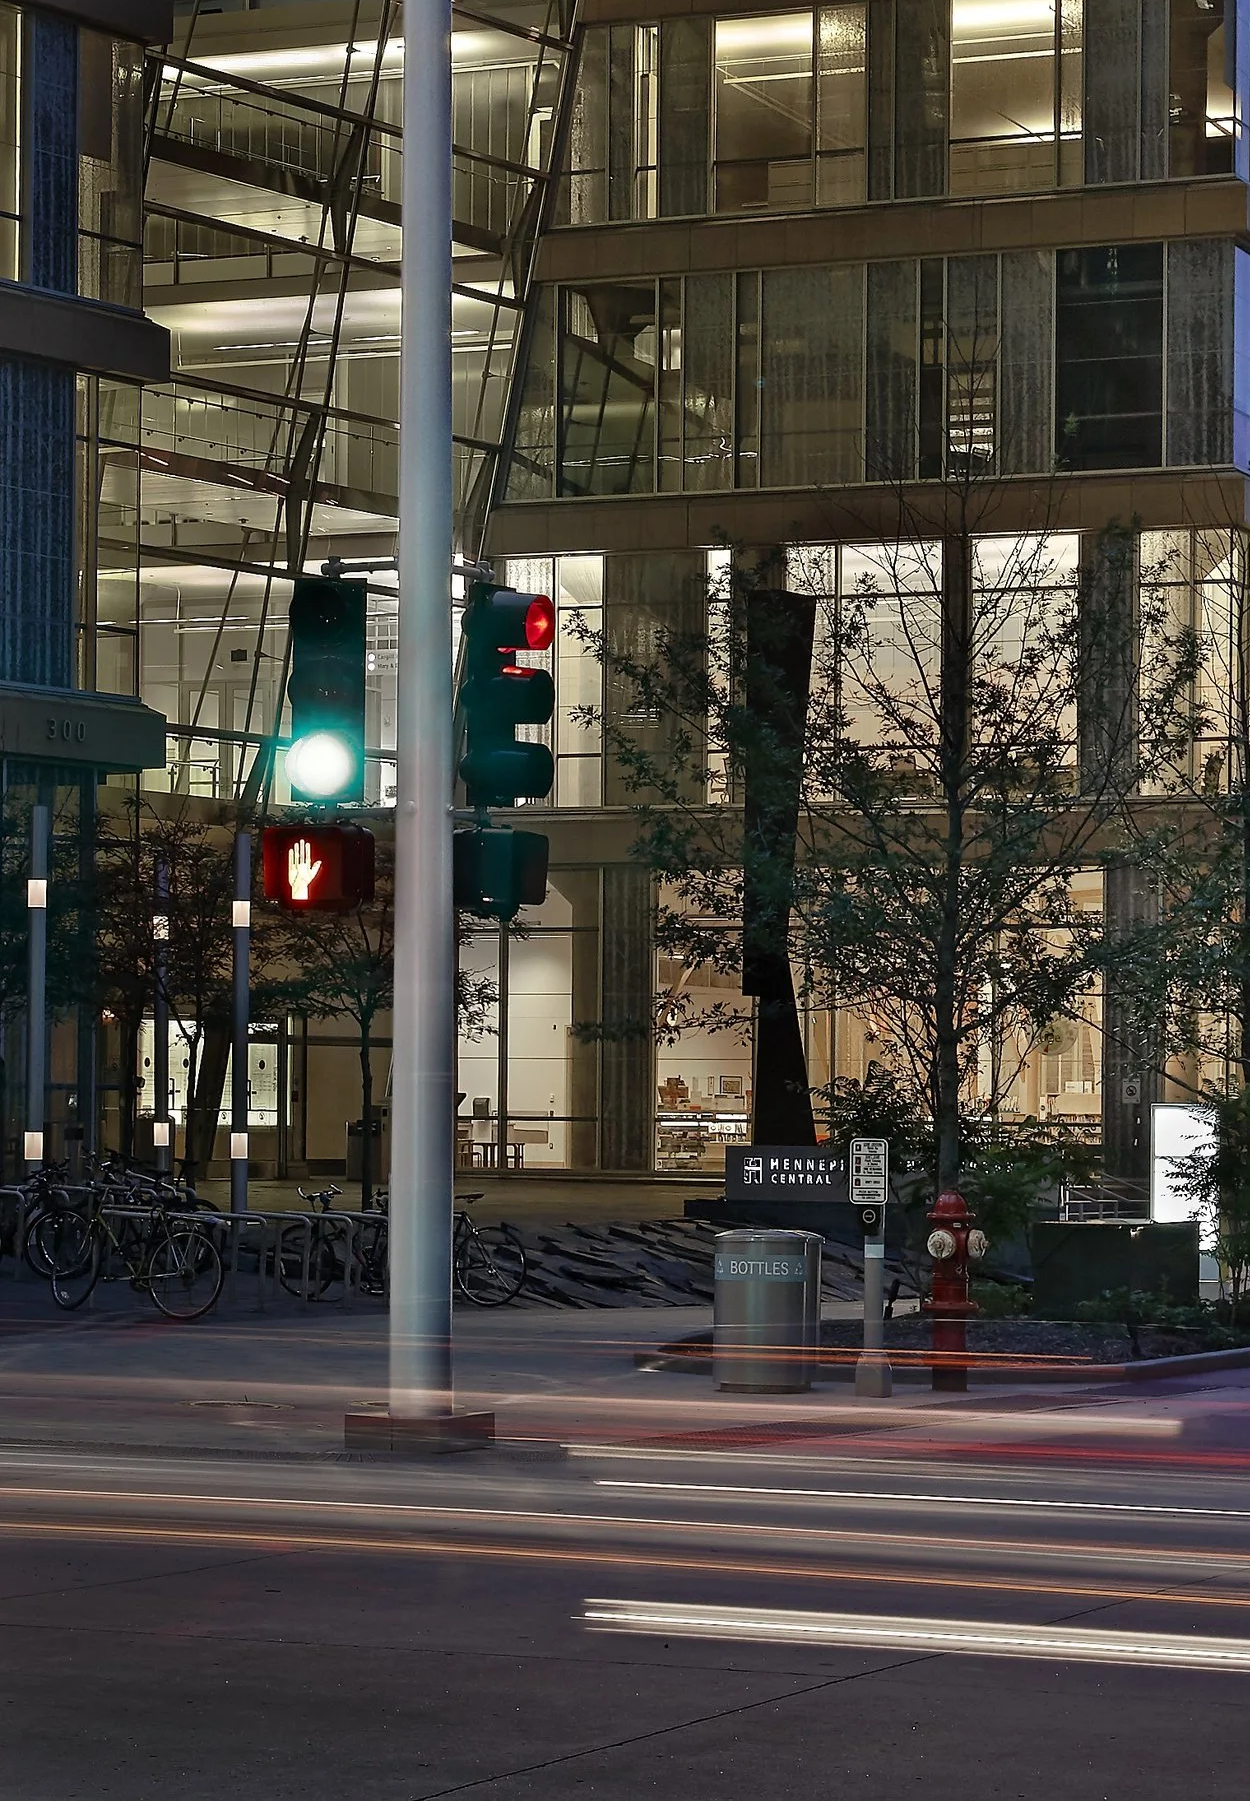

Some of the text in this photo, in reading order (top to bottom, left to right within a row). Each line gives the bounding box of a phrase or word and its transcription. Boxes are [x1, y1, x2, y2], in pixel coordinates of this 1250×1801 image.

[47, 718, 87, 743] 300
[770, 1158, 845, 1171] HENNEPI
[771, 1174, 832, 1185] CENTRAL
[730, 1260, 789, 1276] BOTTLES
